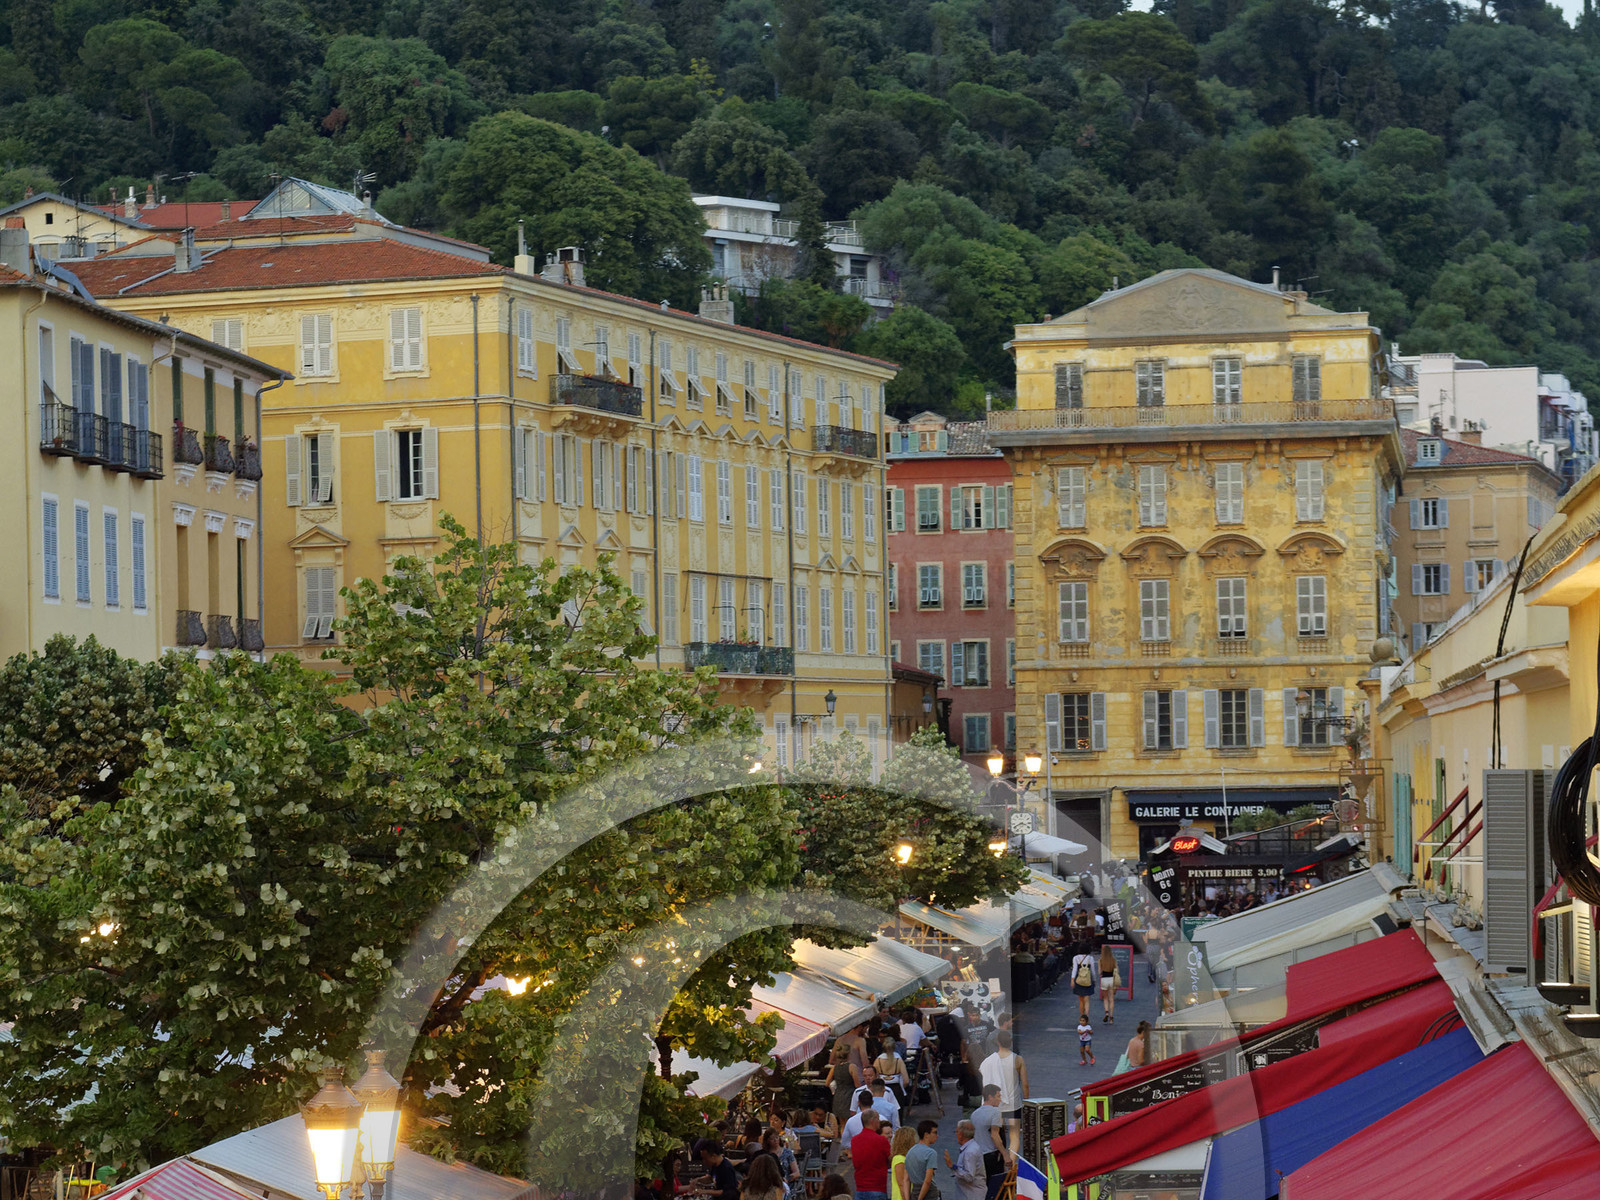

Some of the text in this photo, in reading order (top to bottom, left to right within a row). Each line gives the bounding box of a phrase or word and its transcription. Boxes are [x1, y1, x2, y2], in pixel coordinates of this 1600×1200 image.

[1135, 806, 1181, 818] GALERIE
[1185, 806, 1200, 817] LE
[1173, 838, 1198, 851] Blast
[1152, 868, 1175, 882] MOJITO
[1187, 868, 1225, 878] PINTHE
[1224, 868, 1253, 878] BIERE
[1257, 868, 1278, 878] 3,90
